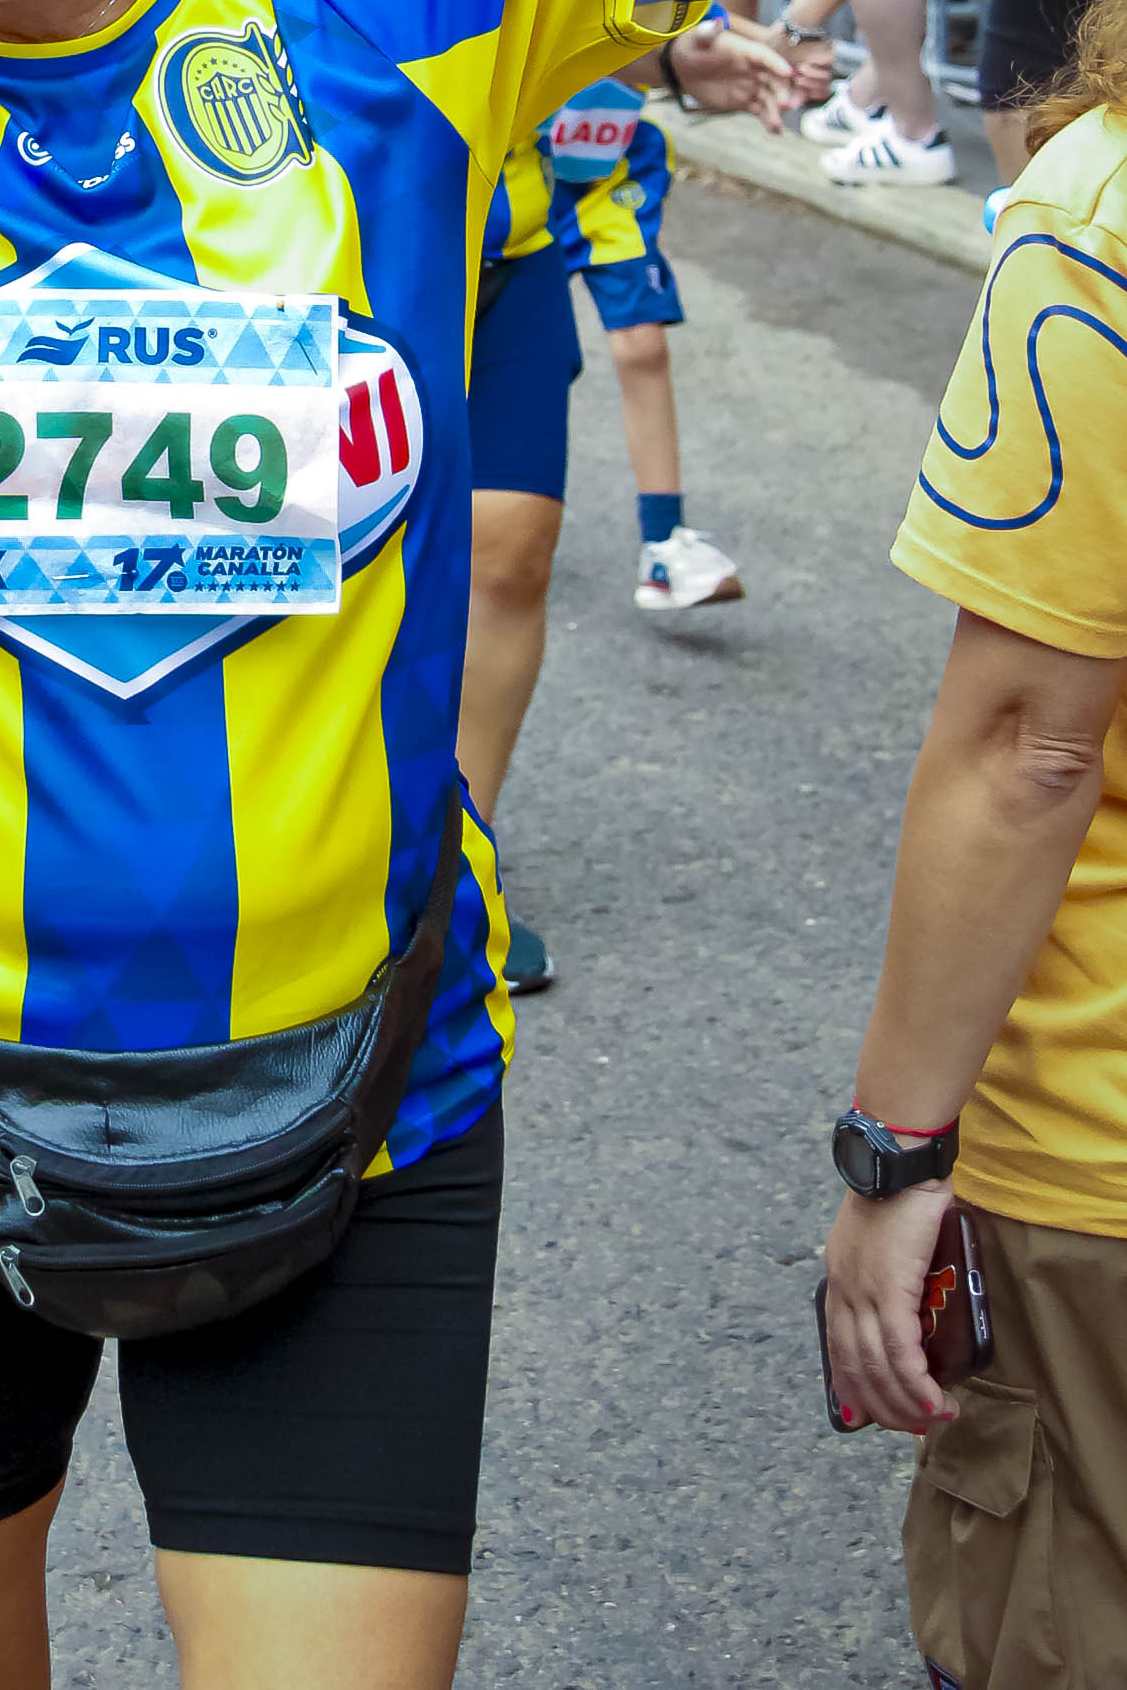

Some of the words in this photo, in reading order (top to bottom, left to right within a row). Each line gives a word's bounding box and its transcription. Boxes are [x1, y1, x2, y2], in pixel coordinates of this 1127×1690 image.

[200, 76, 254, 101] CARC
[195, 543, 304, 561] MARATÓN
[112, 546, 186, 592] 17
[197, 561, 301, 576] CANALLA
